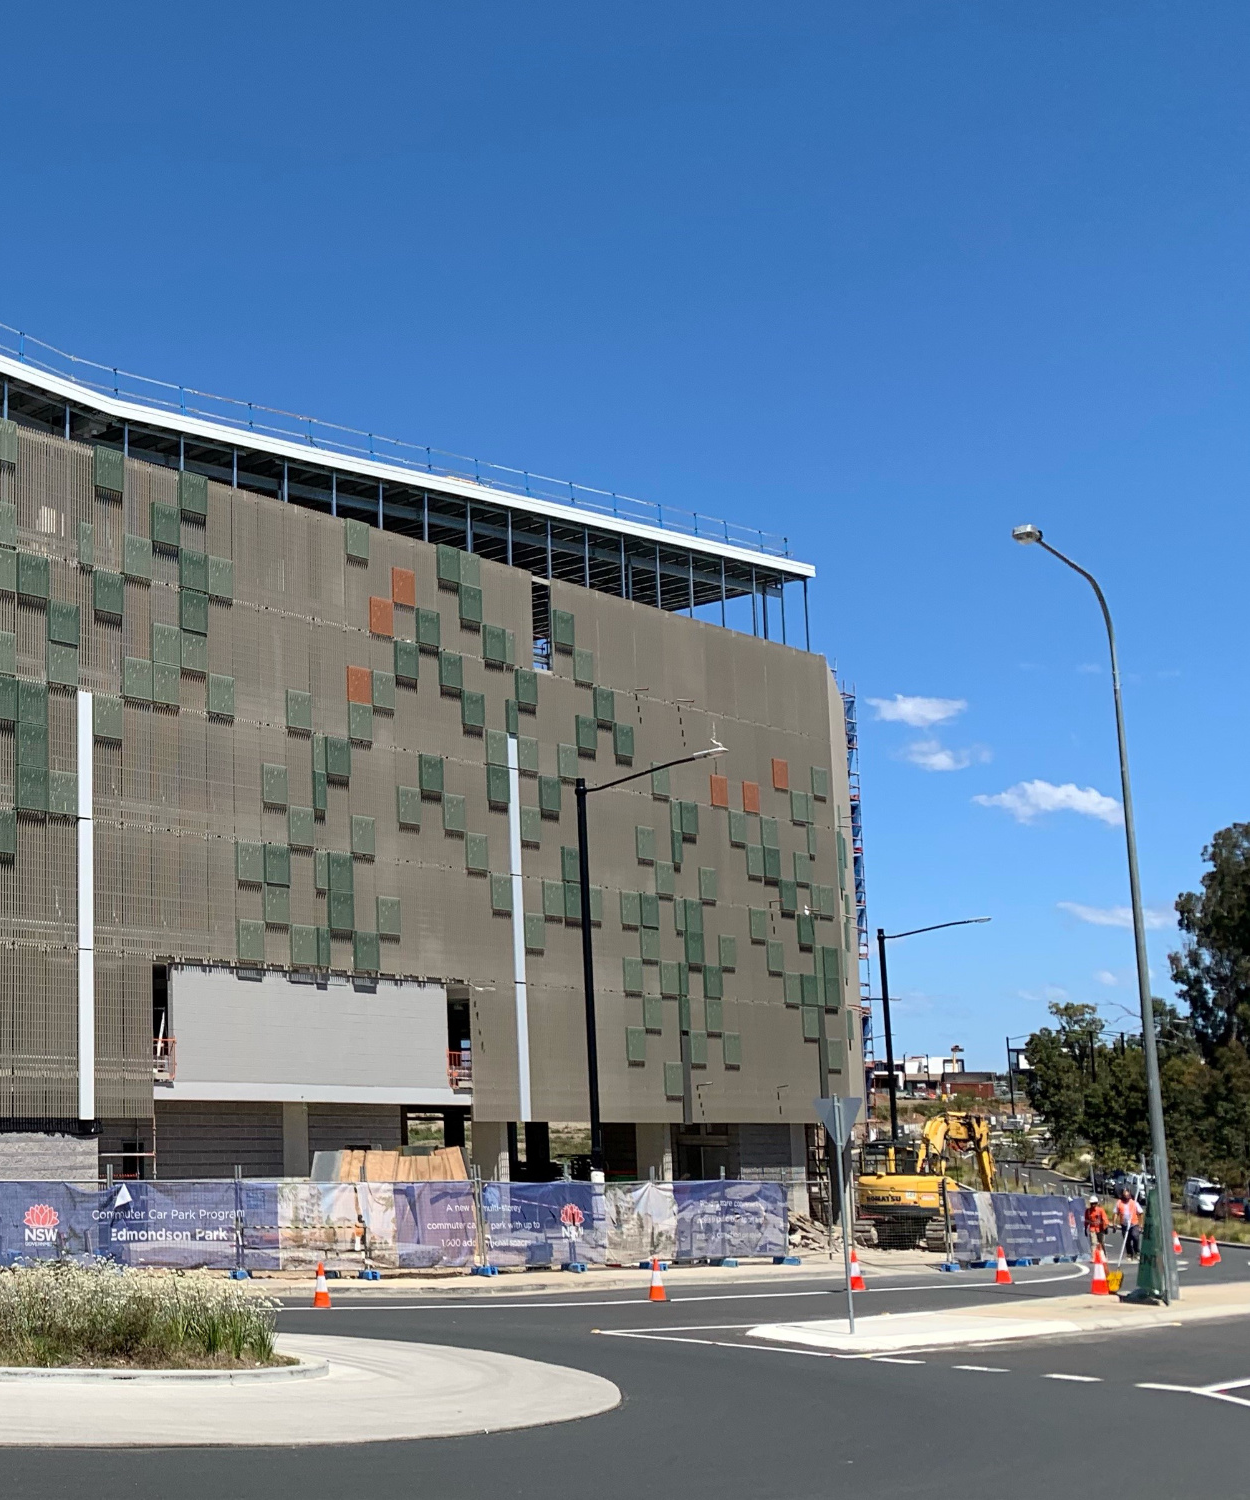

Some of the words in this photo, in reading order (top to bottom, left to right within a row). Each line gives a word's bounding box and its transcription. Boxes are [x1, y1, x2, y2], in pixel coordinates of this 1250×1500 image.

[446, 1204, 453, 1212] A
[454, 1204, 470, 1212] new
[91, 1209, 145, 1220] Commuter
[148, 1209, 167, 1220] Car
[171, 1209, 196, 1220] Park
[199, 1209, 245, 1221] Program
[491, 1221, 506, 1231] park
[524, 1221, 532, 1230] up
[533, 1220, 541, 1229] to
[24, 1228, 58, 1242] NSW
[110, 1227, 191, 1242] Edmondson
[196, 1227, 228, 1241] Park
